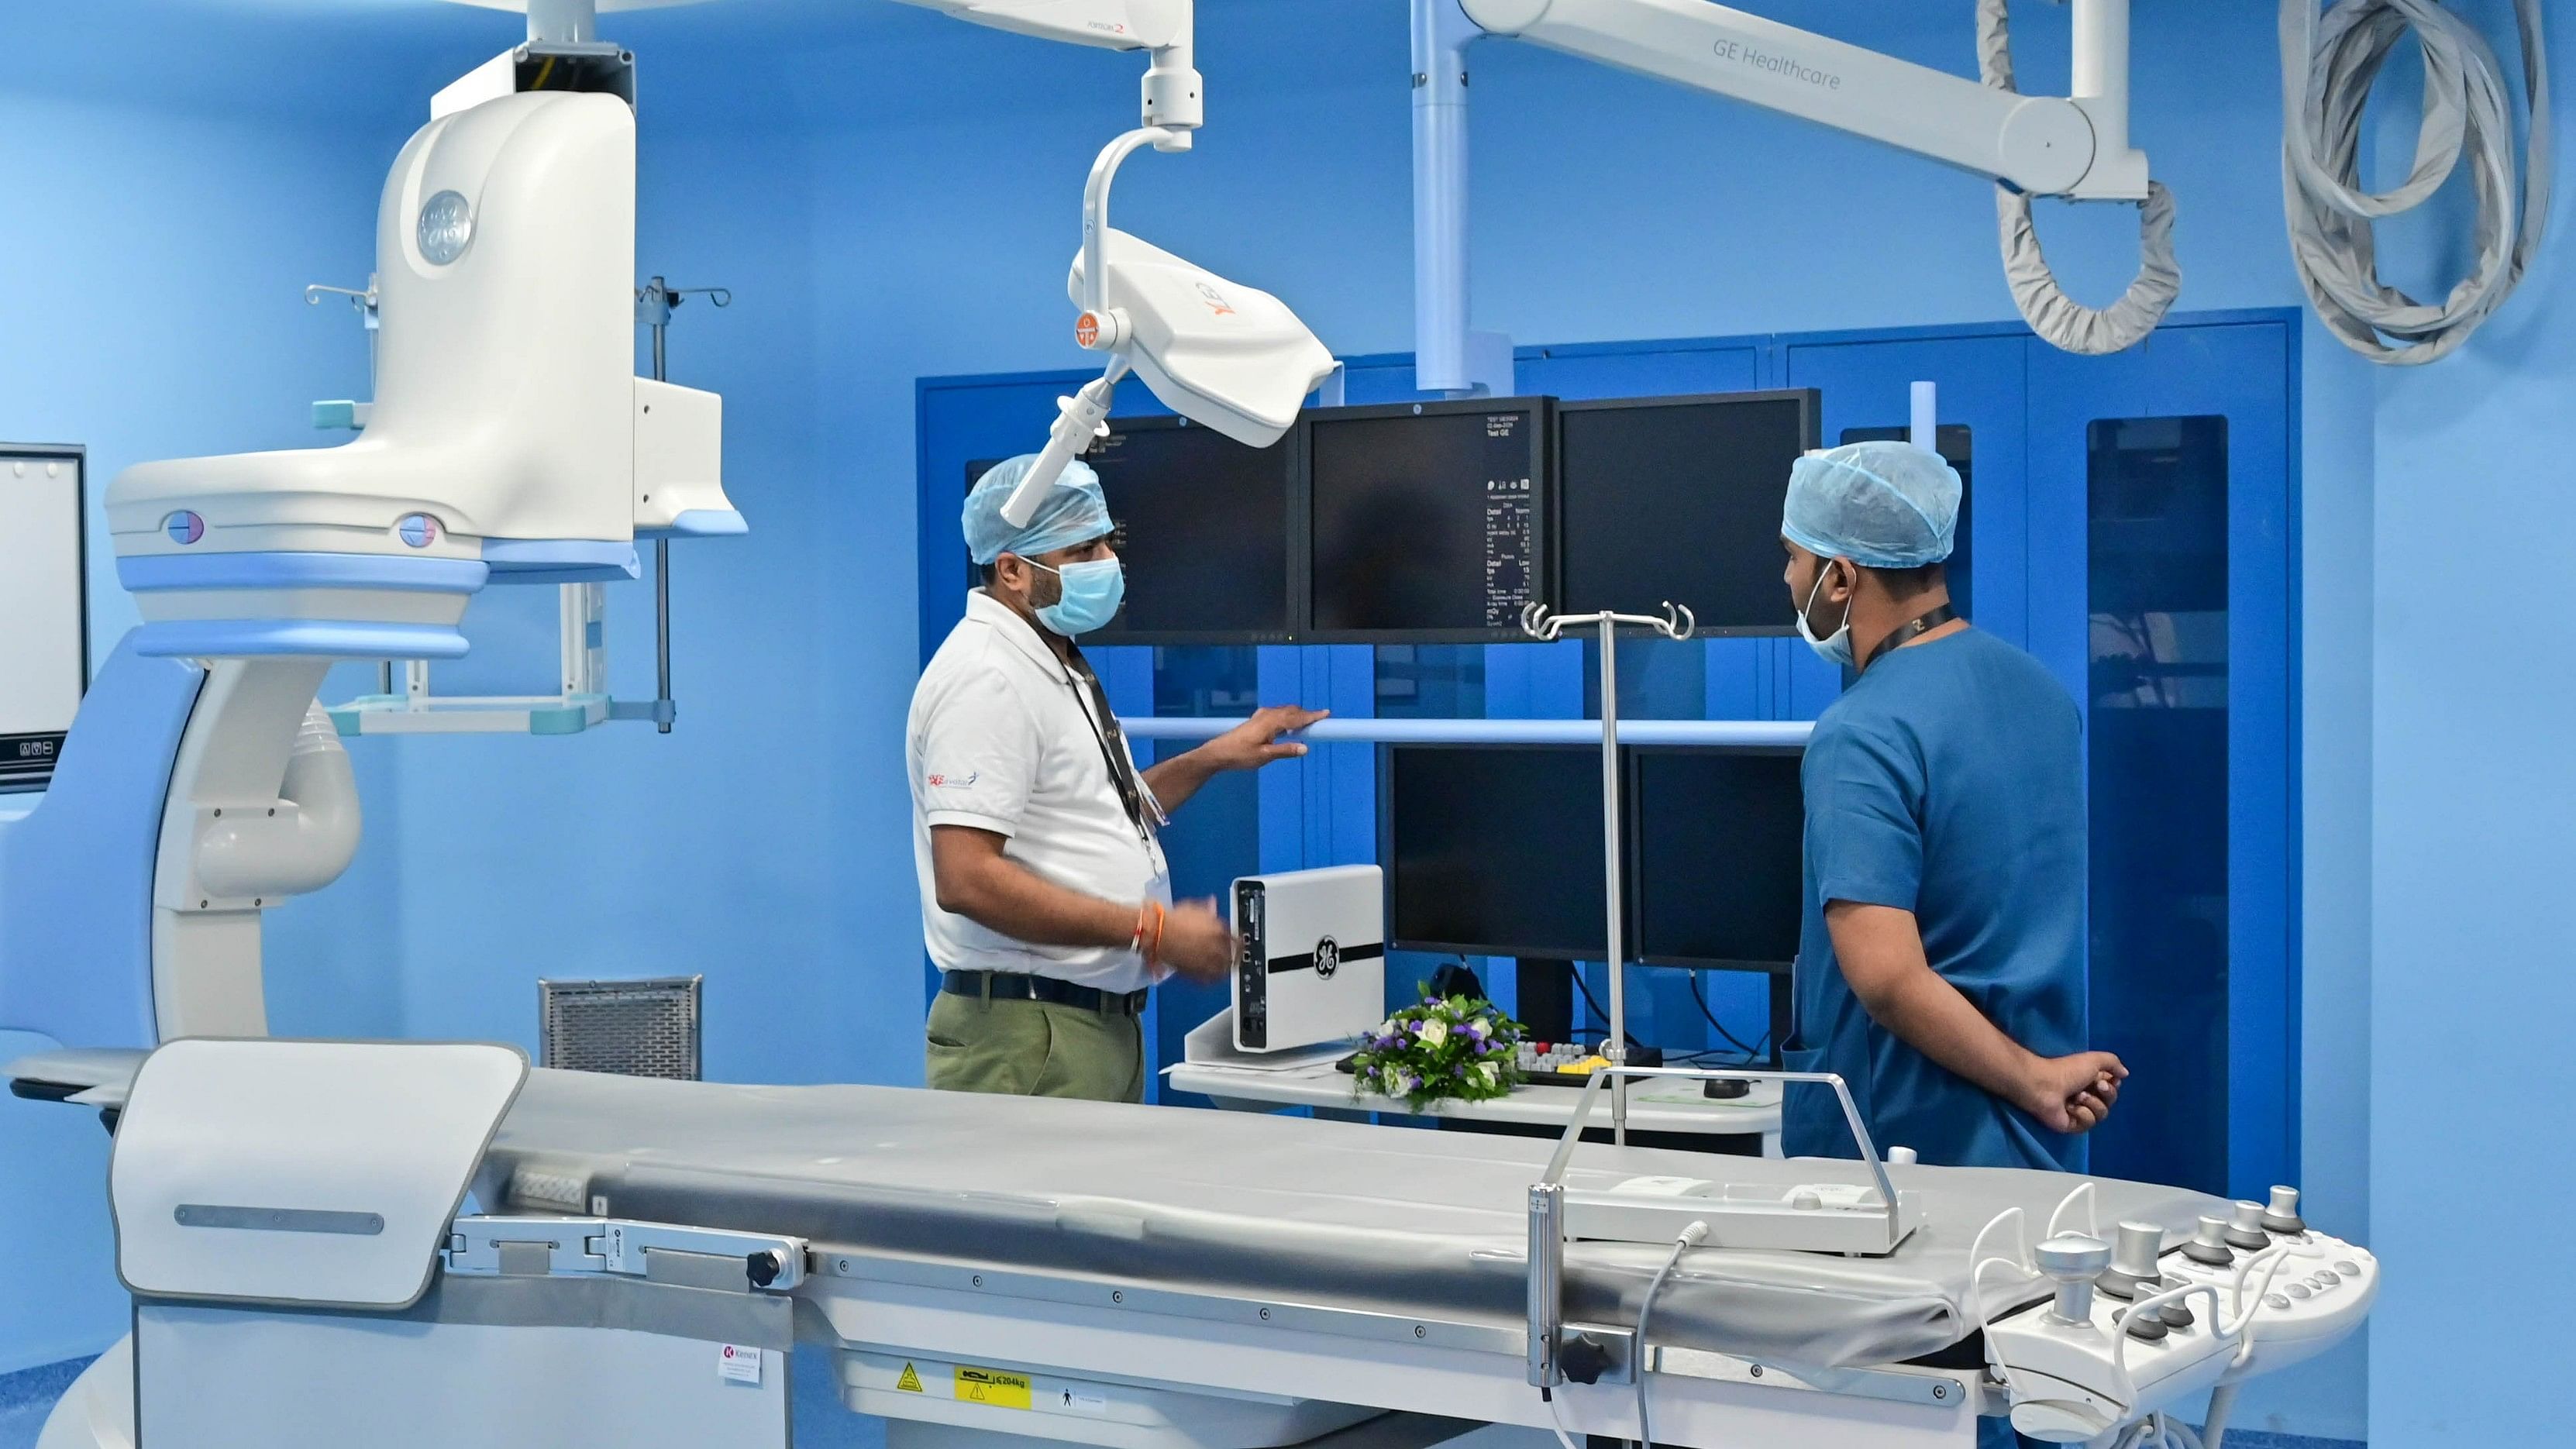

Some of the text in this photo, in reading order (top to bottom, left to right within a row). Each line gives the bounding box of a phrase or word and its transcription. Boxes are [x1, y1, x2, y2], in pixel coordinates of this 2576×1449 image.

[1713, 39, 1841, 90] GE Healthcare
[1487, 429, 1499, 437] Test
